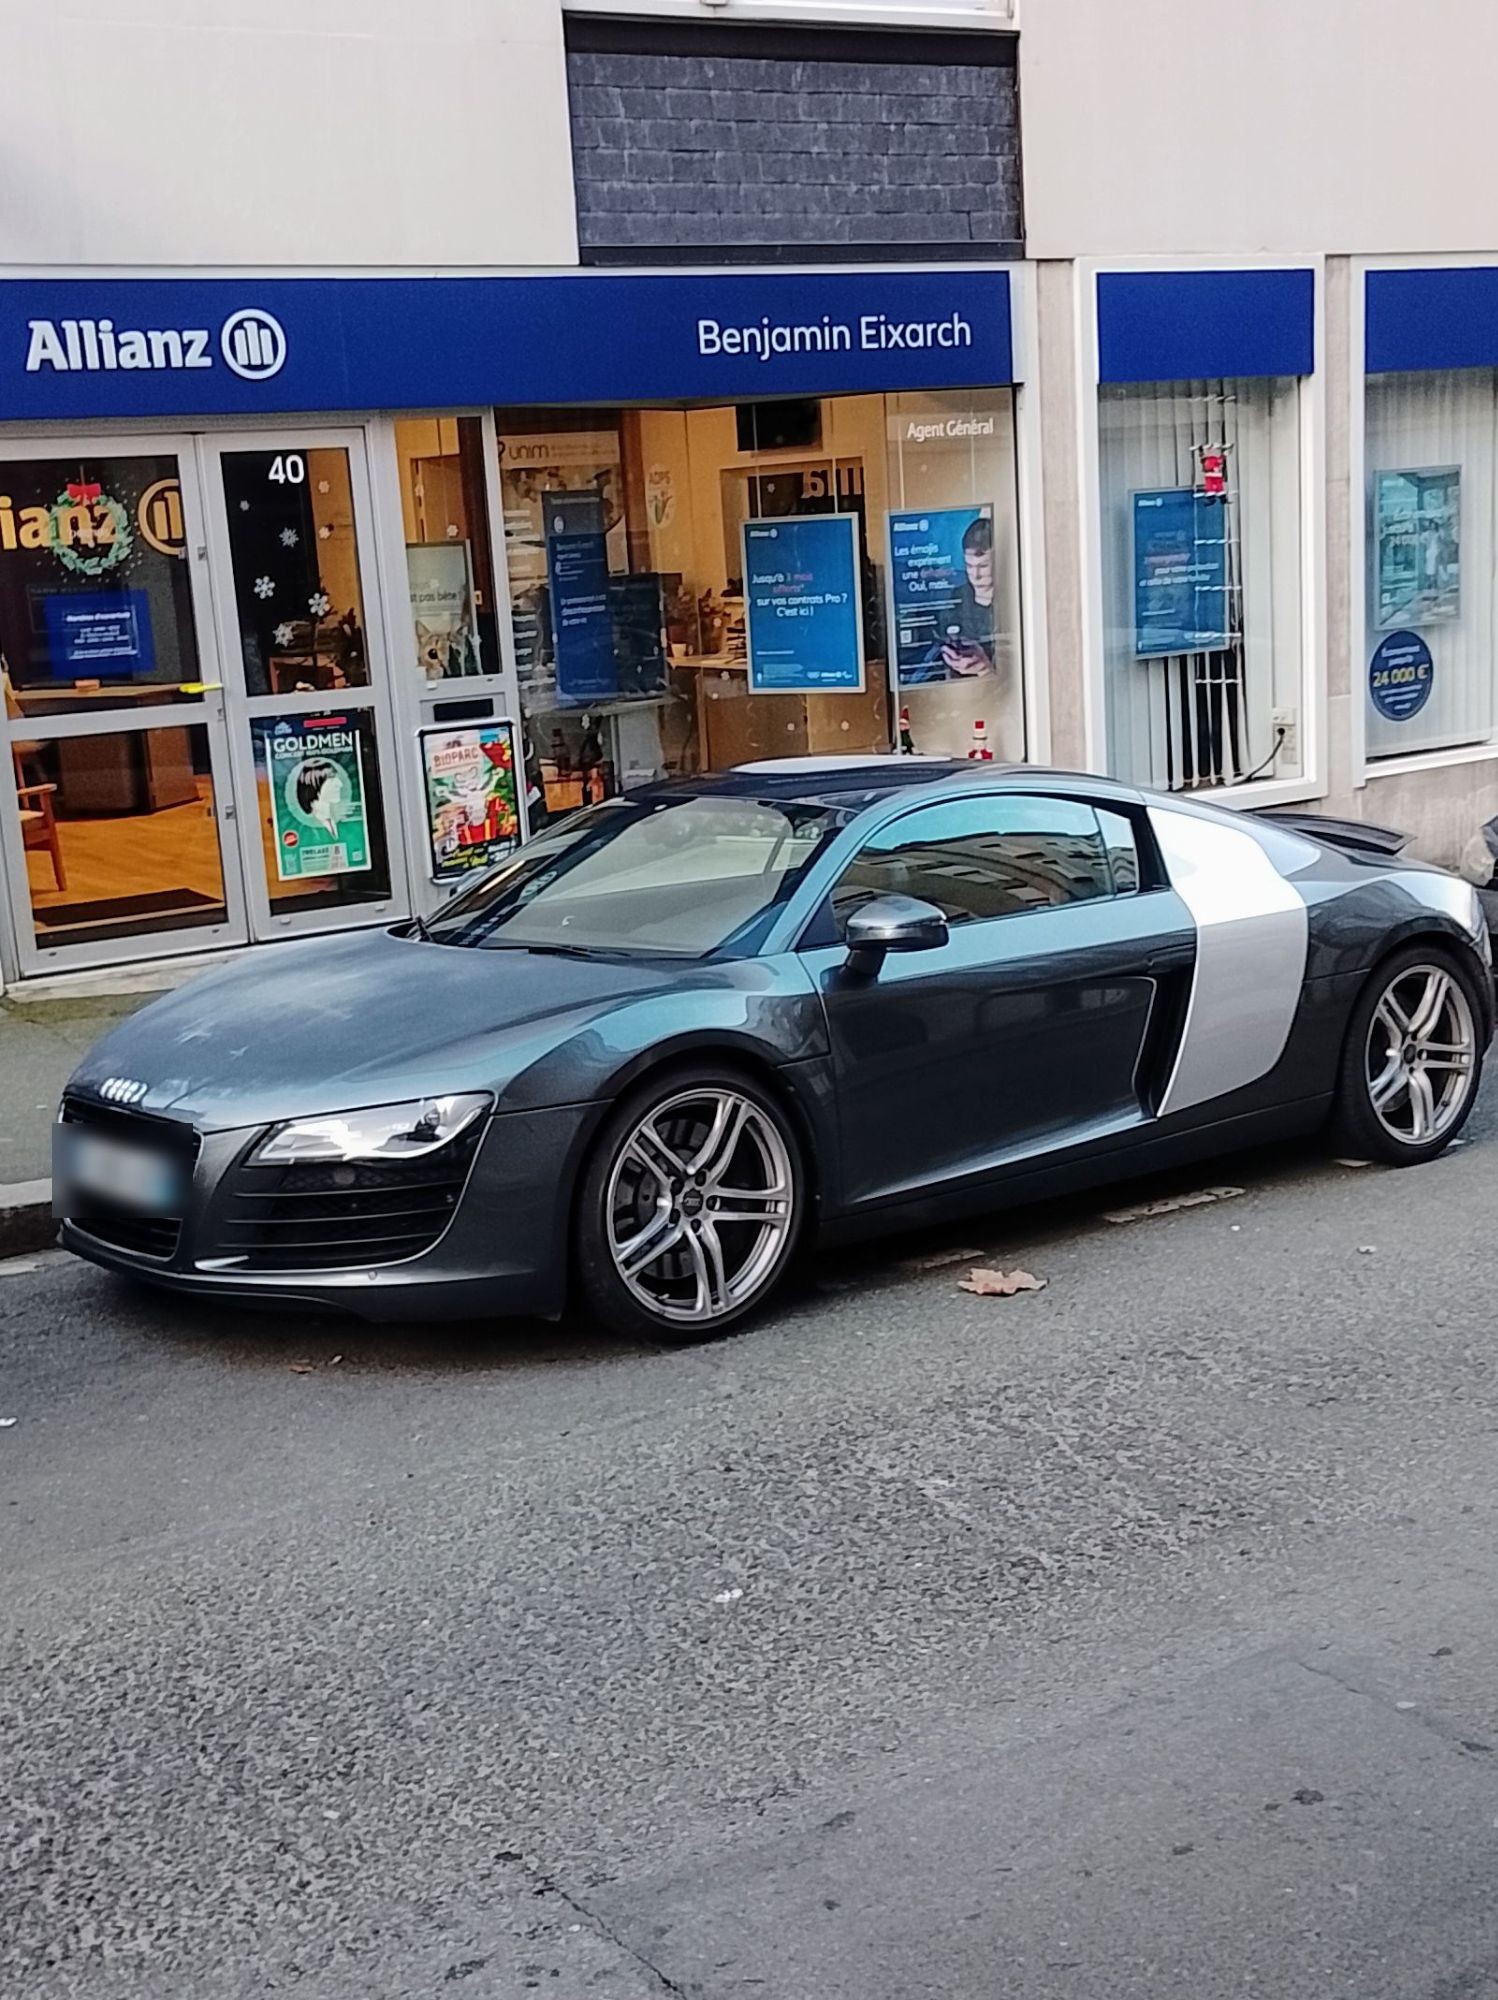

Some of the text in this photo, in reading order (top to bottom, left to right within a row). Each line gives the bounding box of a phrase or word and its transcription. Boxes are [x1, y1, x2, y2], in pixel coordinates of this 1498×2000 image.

[26, 319, 212, 370] Allianz
[698, 313, 971, 360] Benjamin Eixarch
[907, 417, 994, 442] Agent Général
[509, 443, 550, 460] unim
[267, 454, 304, 485] 40
[894, 546, 909, 557] Les
[902, 571, 919, 580] une
[908, 580, 928, 592] Oui,
[757, 598, 771, 607] sur
[772, 598, 786, 606] vos
[786, 595, 824, 606] contrats
[825, 593, 841, 603] Pro
[776, 607, 799, 617] C'est
[1373, 663, 1430, 687] 24 000 €
[273, 731, 353, 753] GOLDMEN
[433, 746, 480, 768] BIOPARC
